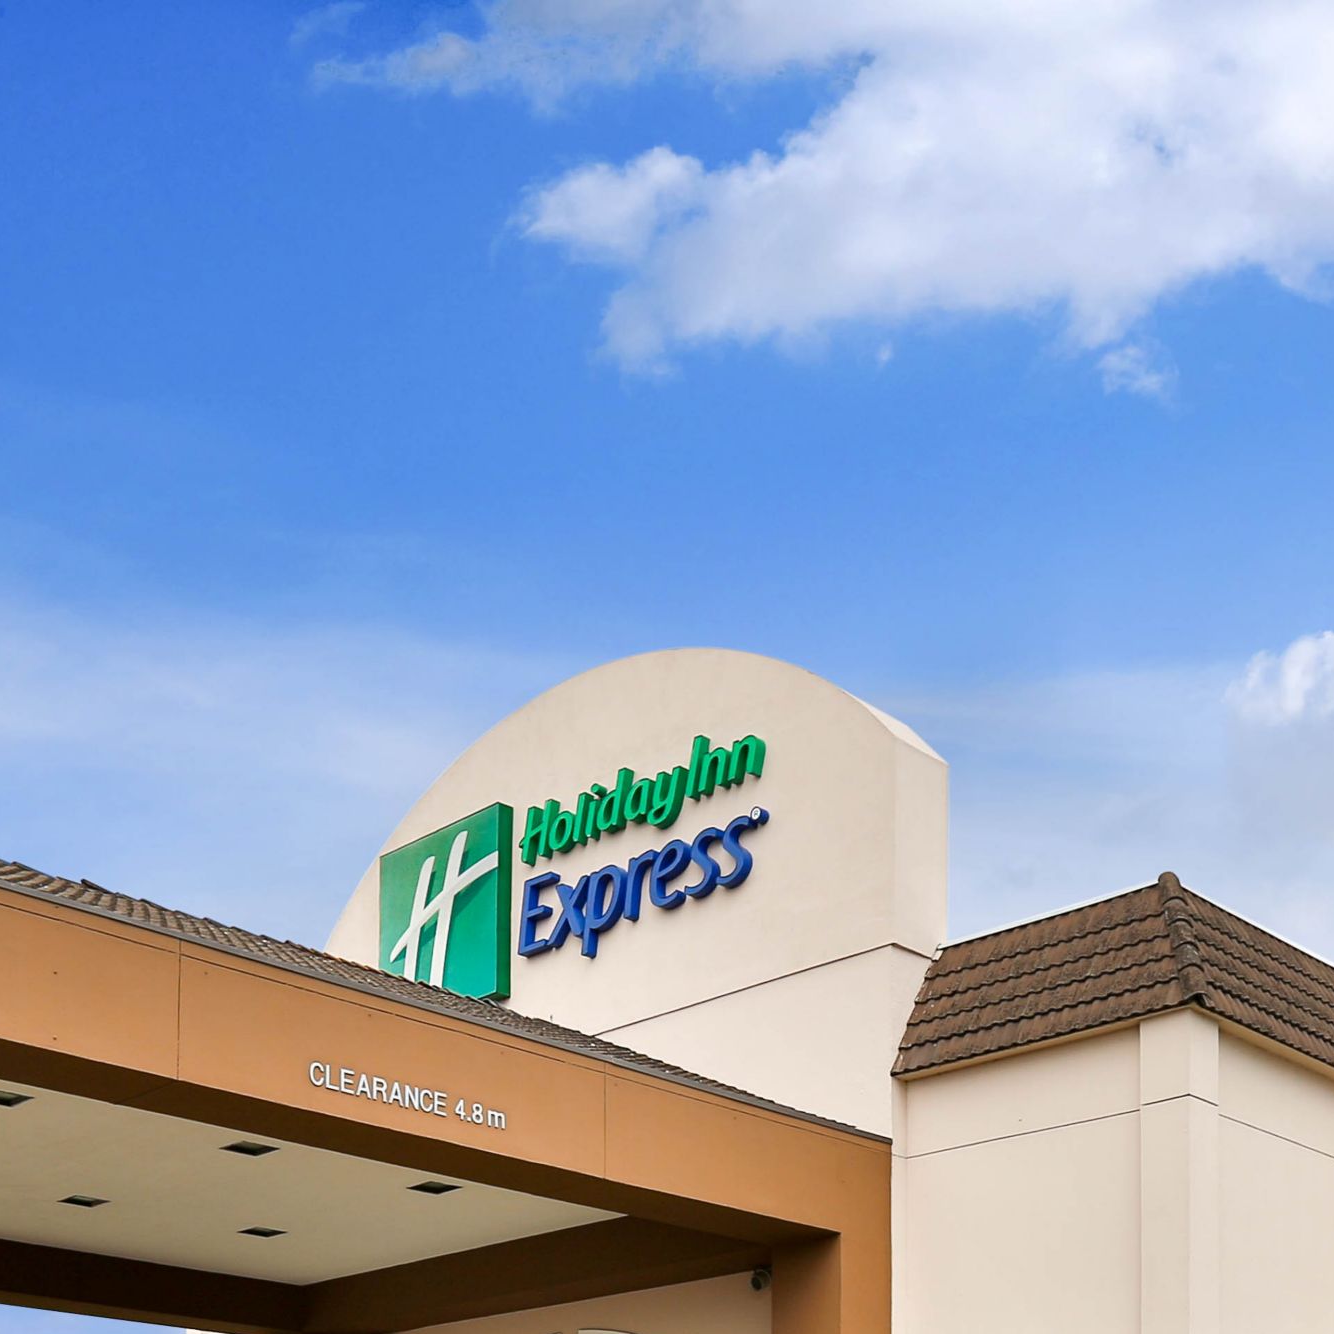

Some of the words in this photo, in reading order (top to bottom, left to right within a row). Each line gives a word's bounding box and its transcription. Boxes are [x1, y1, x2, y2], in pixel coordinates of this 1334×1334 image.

[519, 766, 690, 867] Holiday
[685, 735, 767, 803] Inn
[517, 814, 759, 960] Express
[308, 1061, 449, 1117] CLEARANCE
